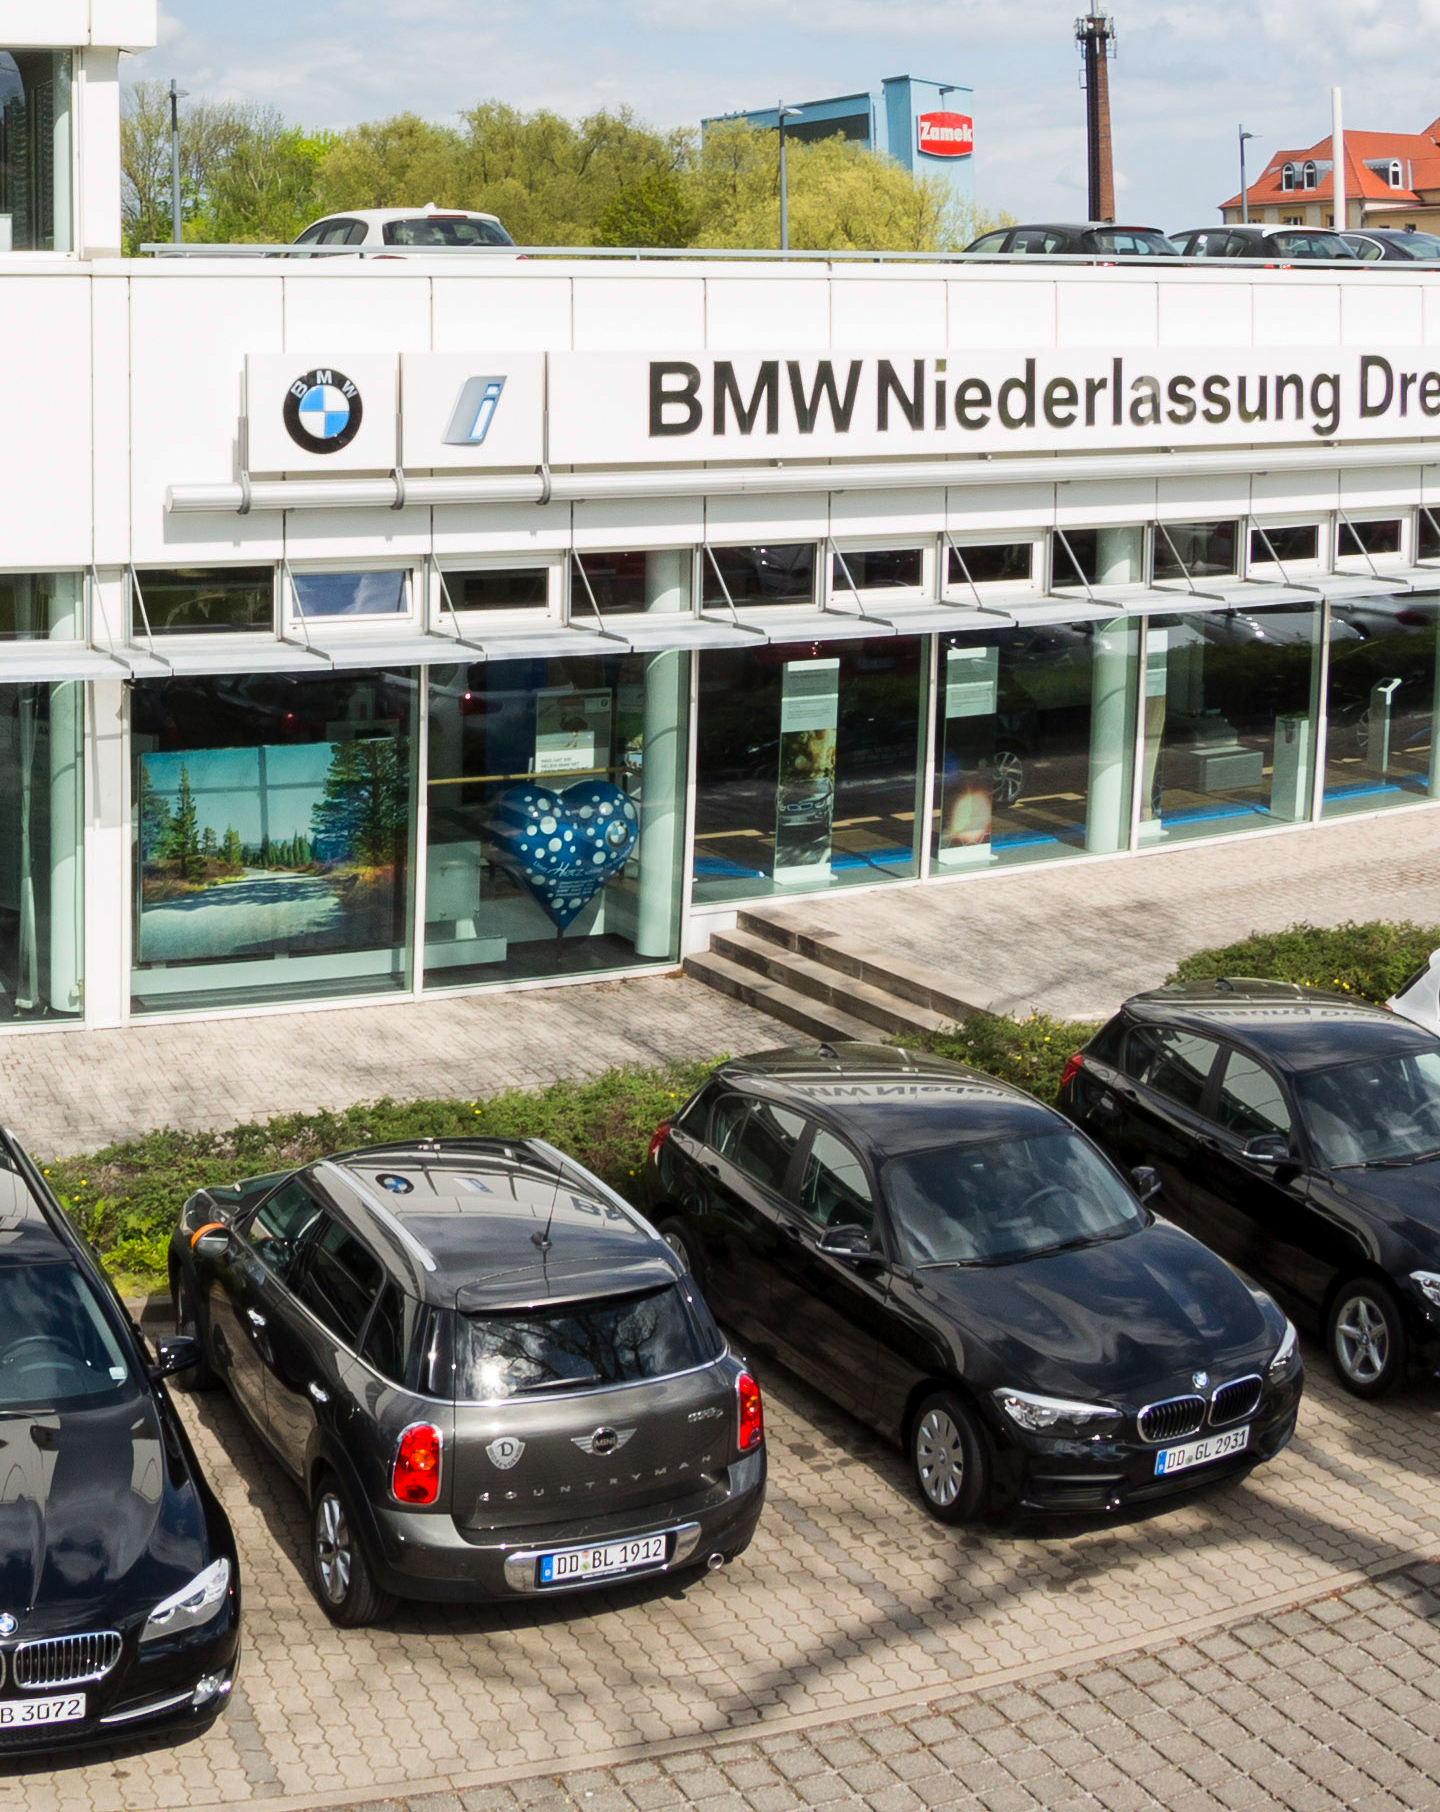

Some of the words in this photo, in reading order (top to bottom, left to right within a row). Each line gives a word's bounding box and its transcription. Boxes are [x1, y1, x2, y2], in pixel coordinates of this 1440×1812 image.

[920, 121, 973, 142] Zamek
[290, 370, 358, 399] BMW
[648, 359, 864, 437] BMW
[876, 356, 1341, 436] Niederlassung
[497, 1441, 514, 1457] D
[596, 1436, 616, 1447] MINI
[1167, 1449, 1186, 1469] DD
[1195, 1442, 1212, 1461] GL
[1214, 1429, 1247, 1455] 2931
[479, 1454, 712, 1502] COUNTRYMAN
[557, 1554, 579, 1575] DD
[591, 1549, 614, 1570] BL
[619, 1538, 663, 1564] 1912
[21, 1699, 81, 1722] 3072
